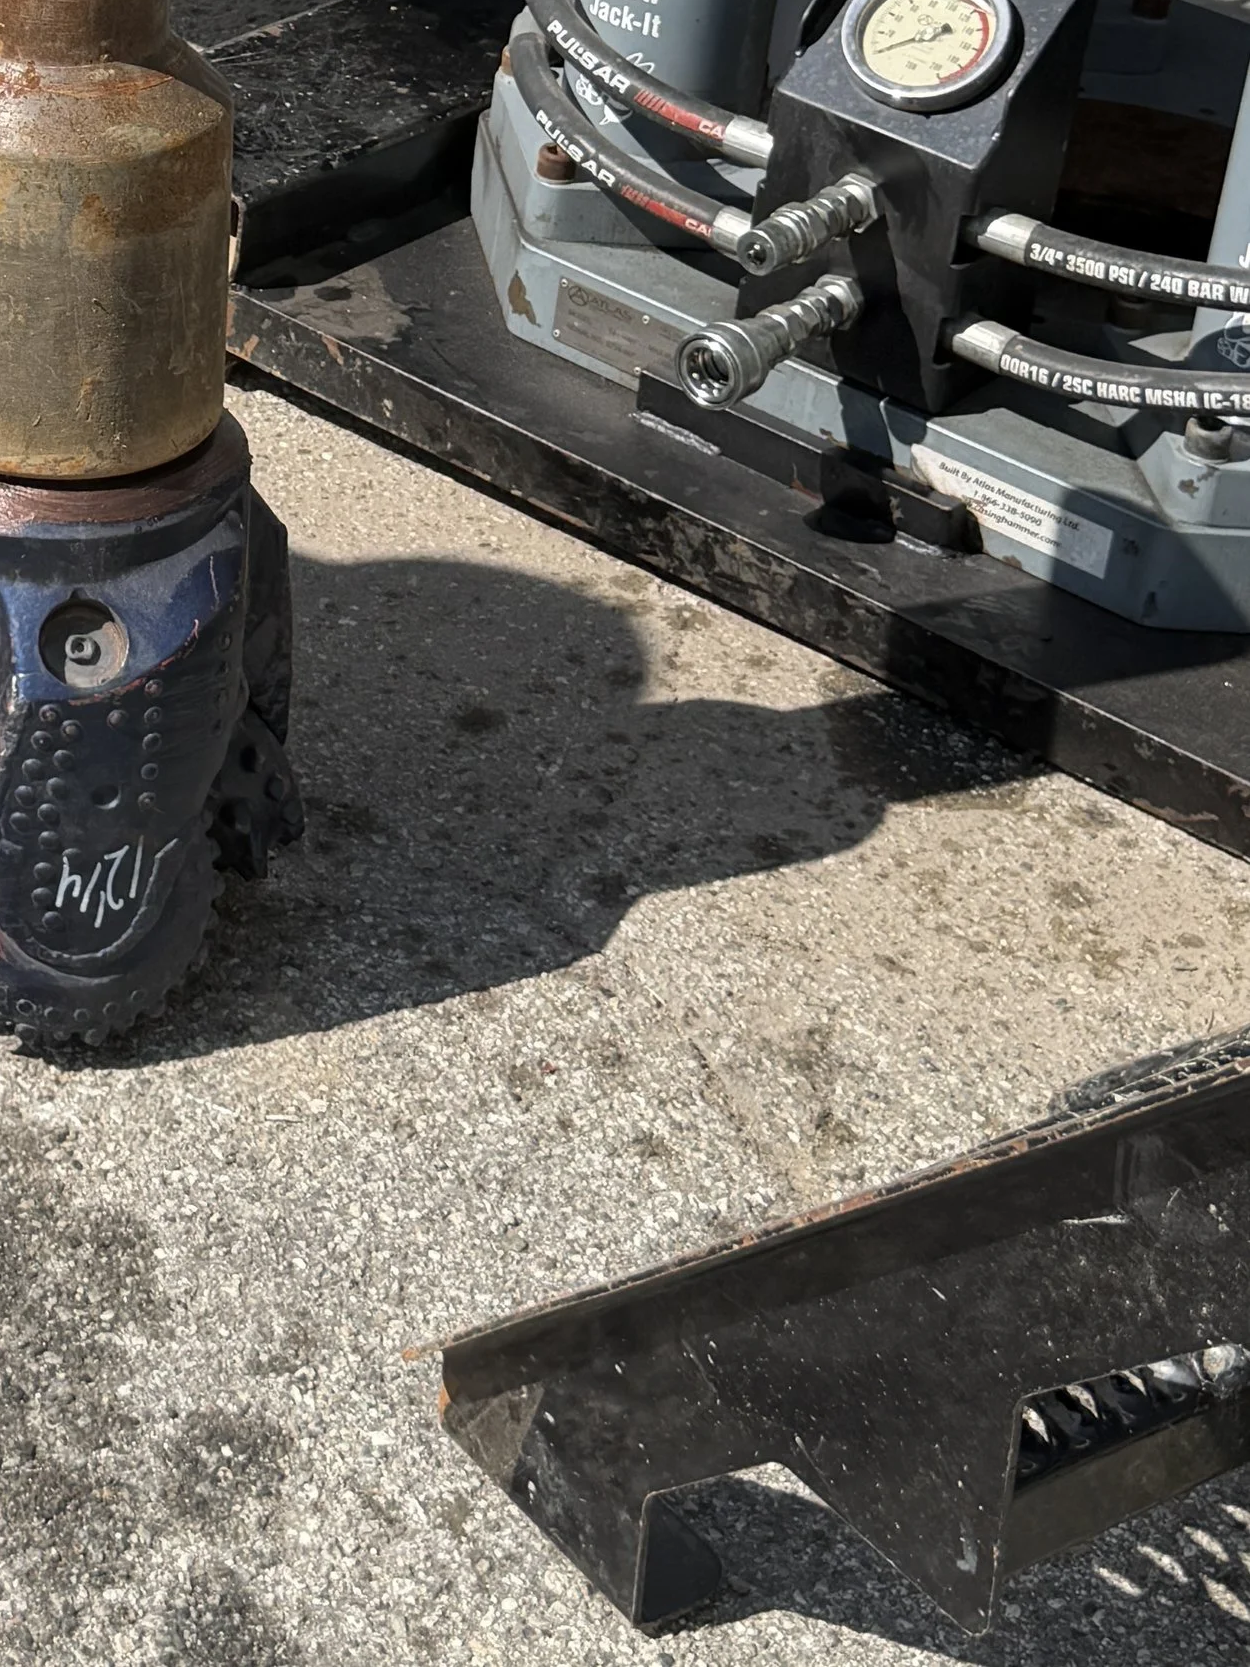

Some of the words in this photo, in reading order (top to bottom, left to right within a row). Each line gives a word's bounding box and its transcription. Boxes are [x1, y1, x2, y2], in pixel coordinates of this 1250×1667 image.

[546, 19, 631, 94] PULSAR
[535, 109, 617, 187] PULSAR
[1065, 253, 1104, 279] 3500
[1109, 265, 1135, 286] PSI
[1150, 273, 1182, 294] 240
[1187, 281, 1224, 301] BAR
[1096, 382, 1142, 404] HARC
[1145, 388, 1198, 408] MSHA
[938, 461, 960, 477] Built
[960, 471, 973, 484] By
[972, 477, 996, 494] Atlas
[995, 486, 1063, 526] Manufacturing
